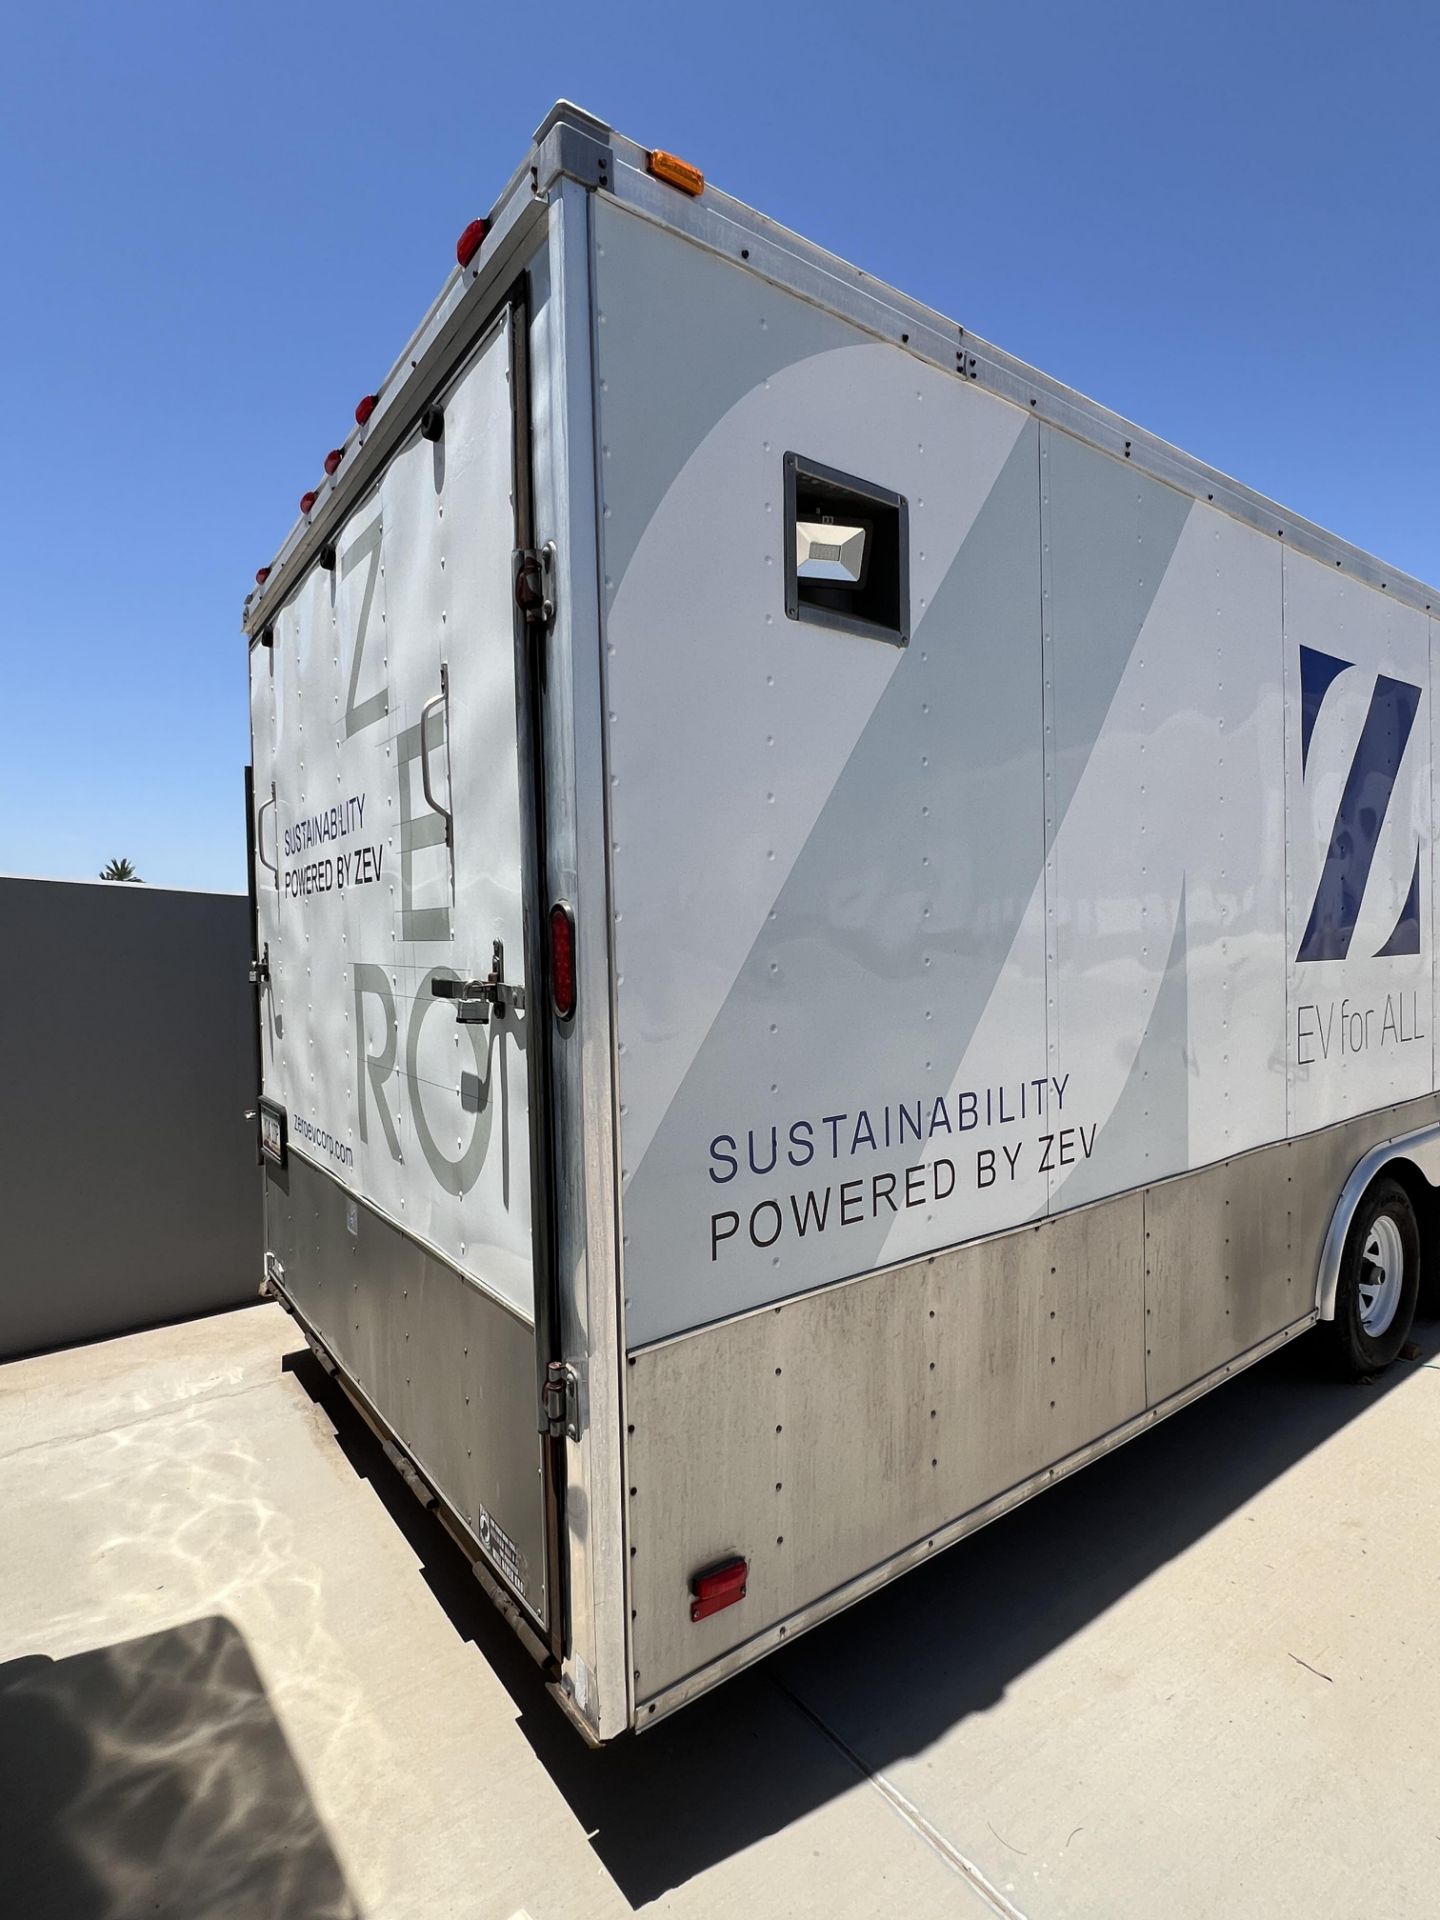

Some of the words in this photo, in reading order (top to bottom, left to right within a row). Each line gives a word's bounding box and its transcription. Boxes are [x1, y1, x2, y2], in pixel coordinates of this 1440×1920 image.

[284, 793, 365, 857] SUSTAINABILITY
[285, 859, 333, 899] POWERED
[337, 852, 352, 889] BY
[354, 844, 383, 885] ZEV
[1298, 1002, 1335, 1065] EV
[1341, 999, 1374, 1055] for
[1381, 991, 1425, 1046] ALL
[709, 1073, 1070, 1184] SUSTAINABILITY
[711, 1158, 956, 1261] POWERED
[976, 1142, 1023, 1189] BY
[1038, 1123, 1097, 1173] ZEV
